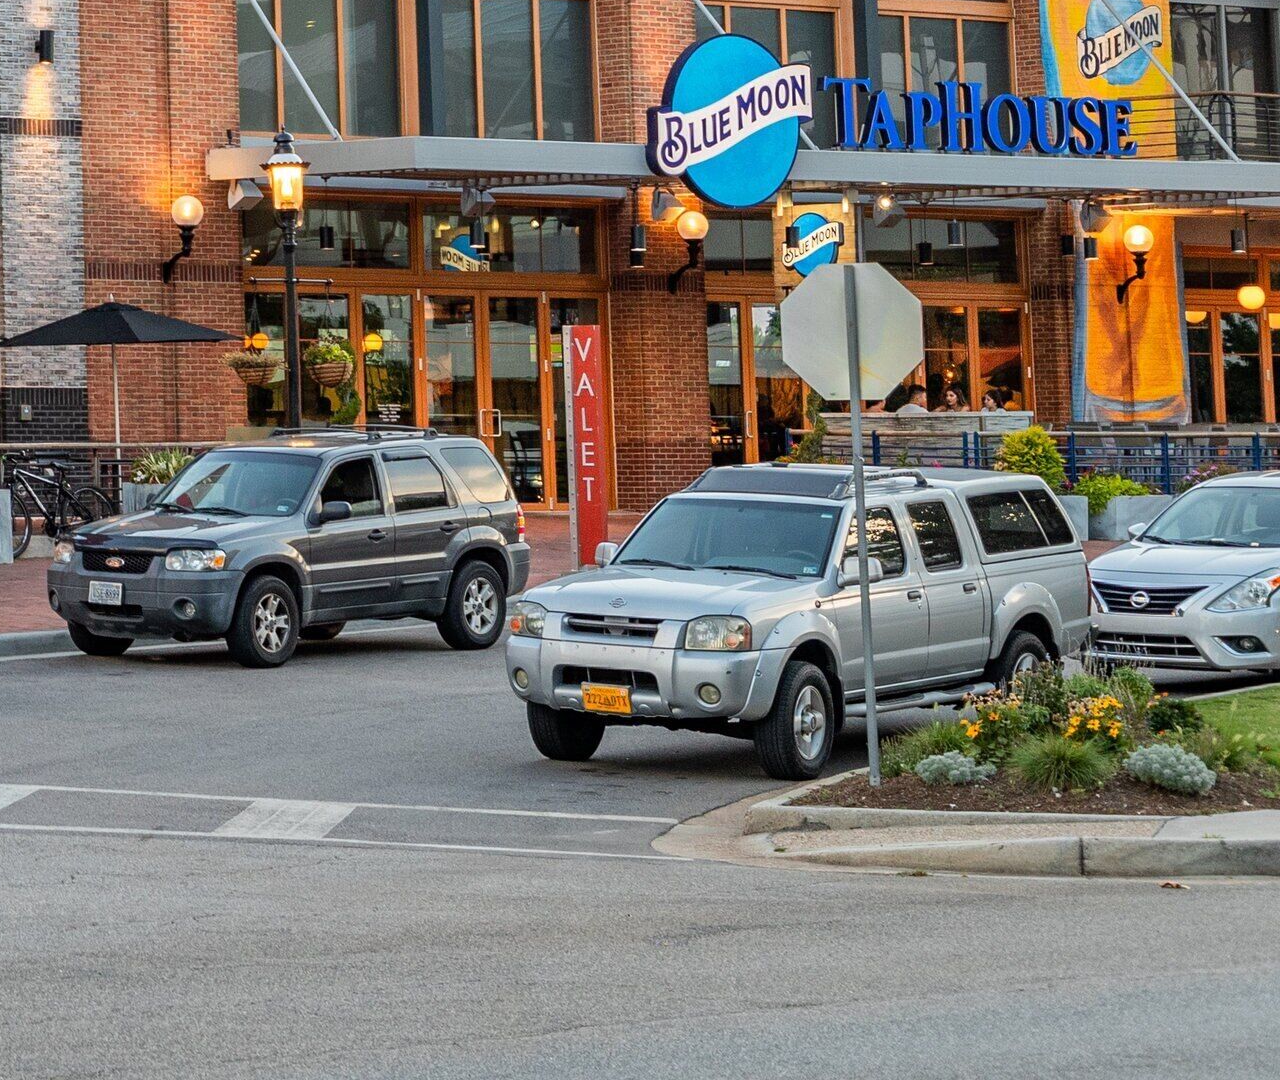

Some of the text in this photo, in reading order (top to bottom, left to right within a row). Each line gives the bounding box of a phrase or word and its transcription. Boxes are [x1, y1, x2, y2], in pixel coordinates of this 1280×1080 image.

[1123, 12, 1159, 51] MOON
[660, 73, 807, 169] BLUE MOON
[811, 225, 837, 249] MOON
[574, 337, 596, 502] VALET
